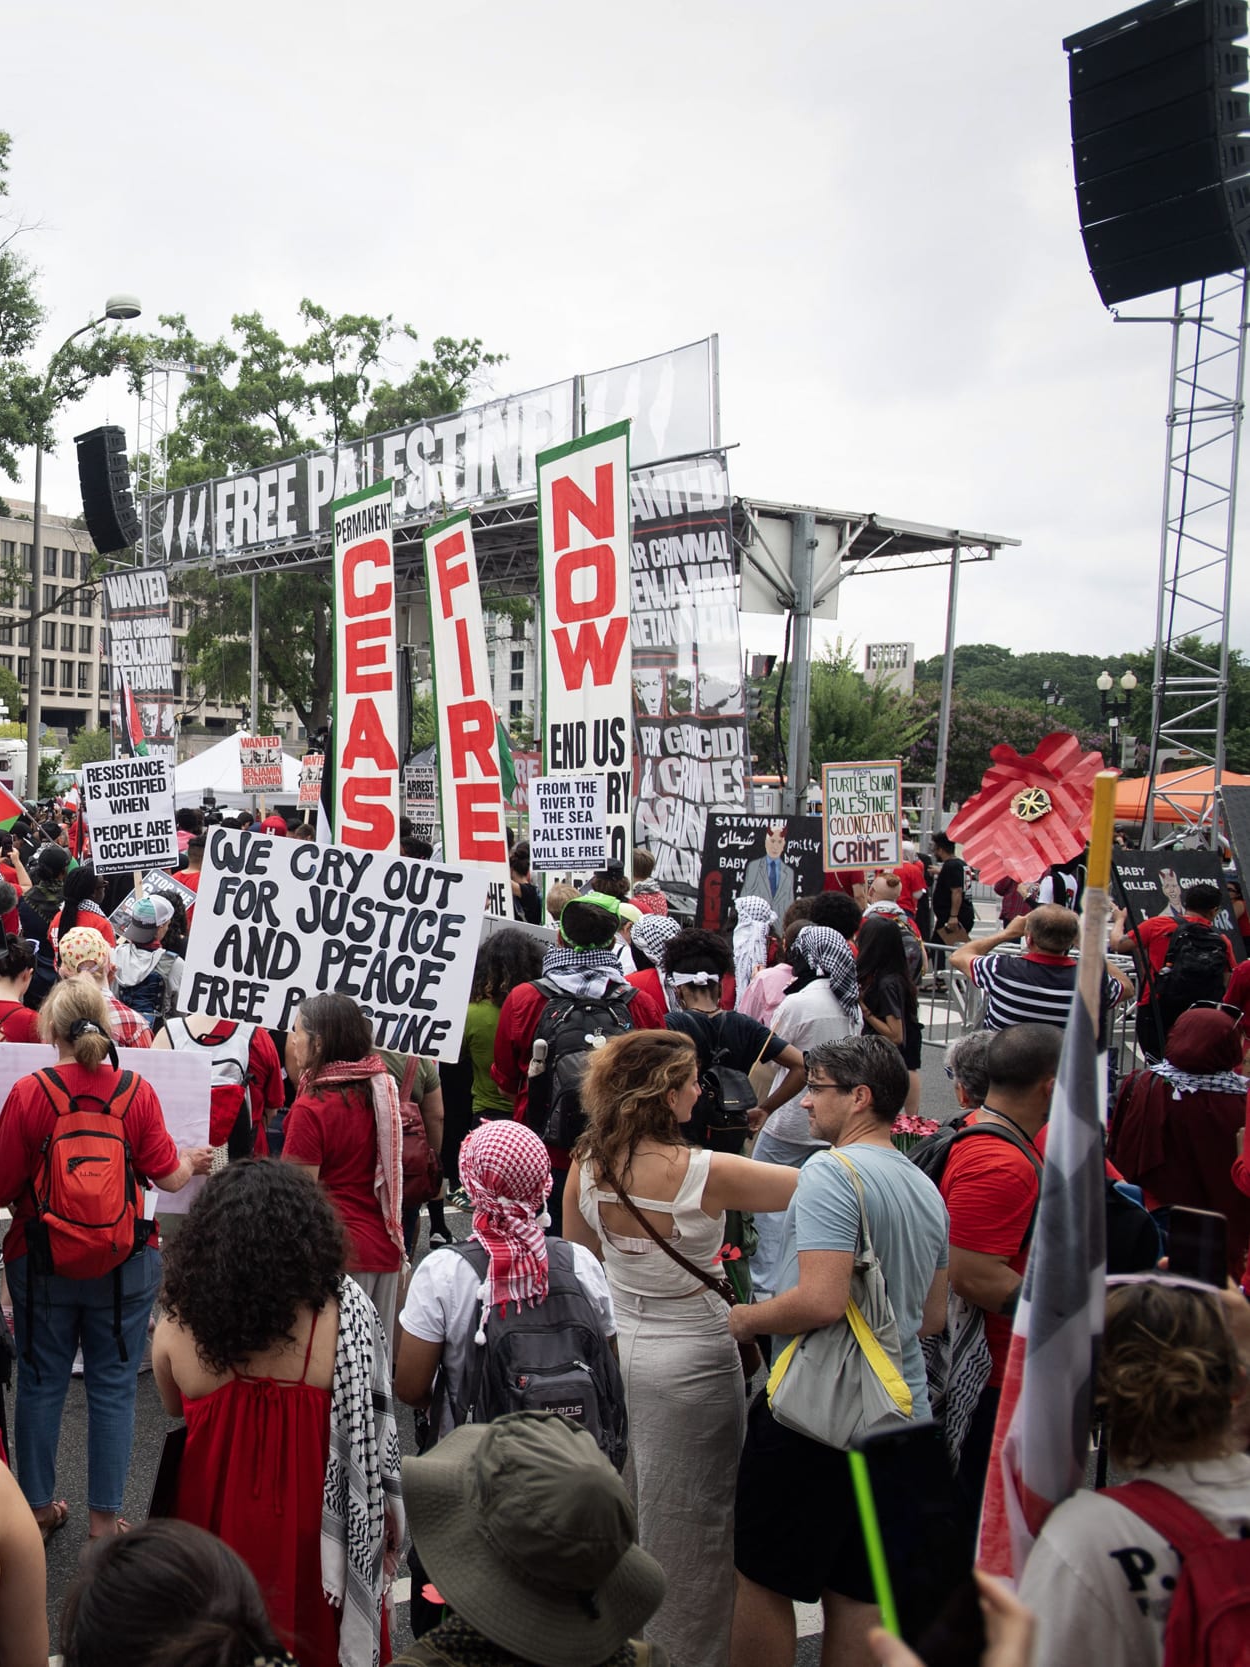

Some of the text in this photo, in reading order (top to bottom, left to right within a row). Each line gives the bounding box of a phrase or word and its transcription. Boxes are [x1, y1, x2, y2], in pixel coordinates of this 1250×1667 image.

[216, 462, 298, 551] FREE
[335, 502, 392, 547] PERMANENT
[551, 462, 628, 691] NOW
[105, 570, 169, 609] WANTED
[110, 620, 132, 640] WAR
[111, 637, 172, 667] BENJAMIN
[433, 530, 506, 863] FIRE
[240, 736, 279, 749] WANTED
[550, 717, 626, 770] END US
[86, 759, 166, 783] RESISTANCE
[242, 766, 282, 777] BENJAMIN
[88, 777, 167, 800] IS JUSTIFIED
[407, 780, 434, 793] ARREST
[536, 782, 571, 796] FROM
[574, 781, 598, 794] THE
[830, 774, 895, 793] TURTLE ISLAND
[109, 796, 150, 815] WHEN
[540, 796, 595, 810] RIVER TO
[830, 795, 894, 815] PALESTINE
[542, 810, 594, 824] THE SEA
[830, 813, 897, 836] COLONIZATION
[93, 819, 173, 843] PEOPLE ARE
[533, 827, 603, 842] PALESTINE
[99, 838, 170, 860] OCCUPIED!
[532, 845, 605, 859] WILL BE FREE
[832, 838, 890, 864] CRIME
[210, 828, 463, 909] WE CRY OUT
[719, 856, 748, 869] BABY
[784, 854, 802, 868] boy
[1116, 865, 1145, 876] BABY
[148, 872, 175, 892] STOP
[213, 876, 466, 962] FOR JUSTICE
[213, 924, 447, 1011] AND PEACE
[187, 972, 270, 1024] FREE
[545, 1405, 583, 1417] trans
